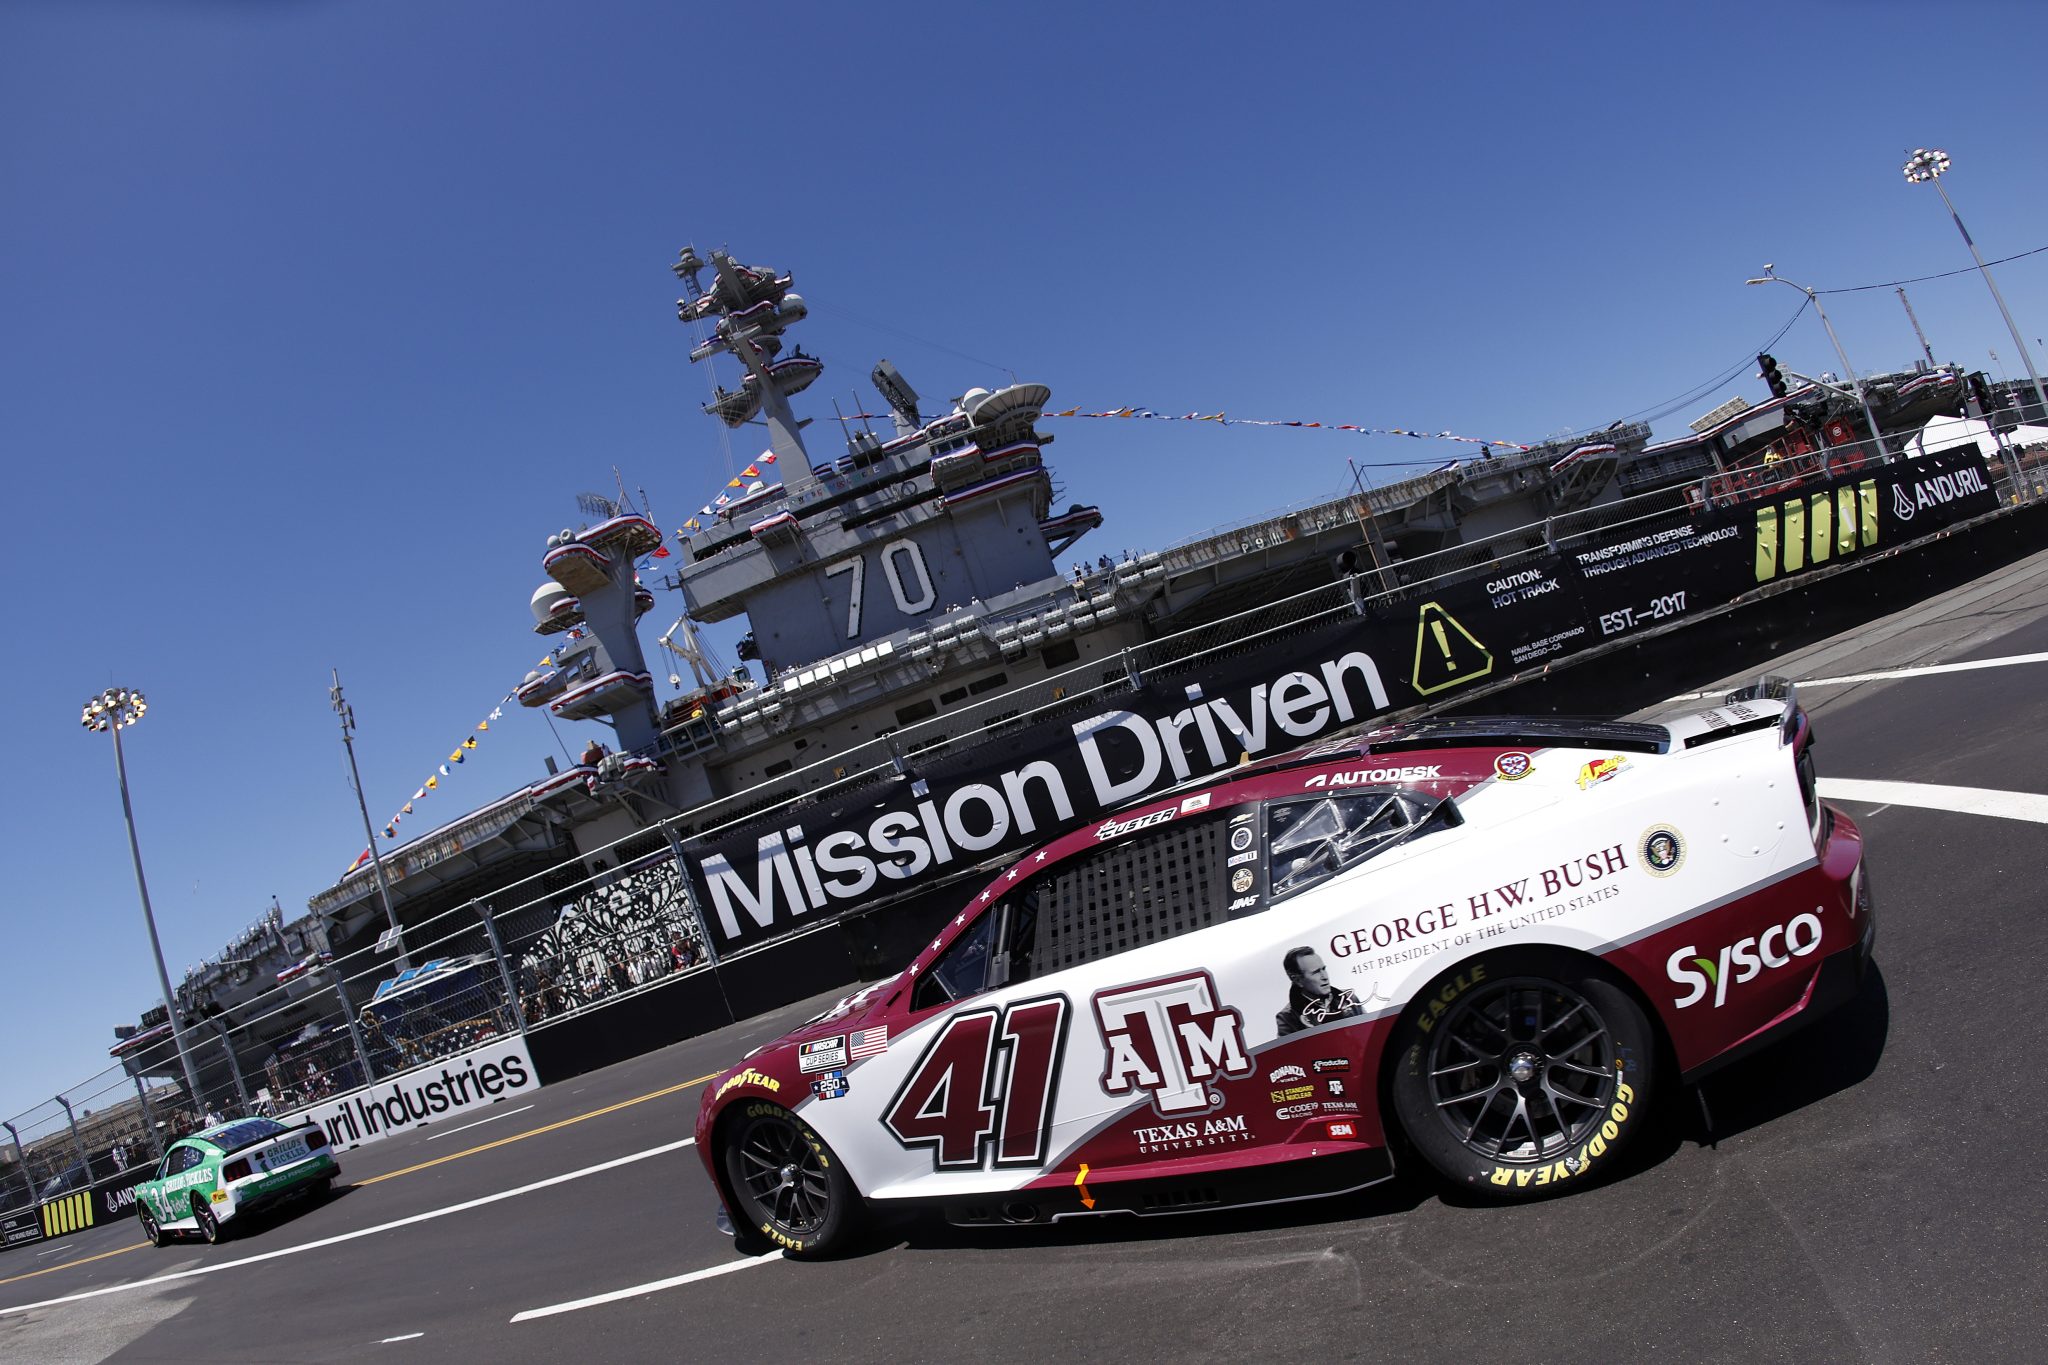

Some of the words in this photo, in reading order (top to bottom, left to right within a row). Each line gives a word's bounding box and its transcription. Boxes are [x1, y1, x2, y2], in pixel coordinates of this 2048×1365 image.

[1914, 467, 1988, 510] ANDURIL
[1576, 537, 1653, 566] TRANSFORMING
[1655, 525, 1695, 543] DEFENSE
[1582, 556, 1632, 578] THROUGH
[1632, 541, 1681, 564] ADVANCED
[1682, 525, 1738, 552] TECHNOLOGY
[825, 538, 938, 640] 70
[1486, 569, 1542, 594] CAUTION:
[1492, 591, 1517, 609] HOT
[1519, 578, 1560, 602] TRACK
[1511, 641, 1532, 657] NAVAL
[1532, 637, 1549, 651] BASE
[1549, 626, 1585, 645] CORONADO
[1514, 653, 1528, 664] SAN
[1329, 765, 1442, 785] AUTODESK
[700, 758, 1074, 940] Mission
[1073, 651, 1389, 803] Driven
[1330, 903, 1459, 959] GEORGE
[1468, 878, 1534, 921] H.W.
[1540, 844, 1629, 898] BUSH
[1351, 959, 1375, 975] 41ST
[1378, 938, 1450, 970] PRESIDENT
[1455, 932, 1473, 947] OF
[1476, 922, 1506, 941] THE
[1509, 904, 1566, 930] UNITED
[1571, 884, 1621, 911] STATES
[1417, 964, 1487, 1033] EAGLE
[806, 1057, 817, 1066] CUP
[818, 1052, 839, 1063] SERIES
[812, 1039, 838, 1053] NASCAR
[716, 1068, 780, 1100] GOODYEAR
[820, 1079, 840, 1091] 250
[879, 992, 1070, 1173] 41
[1270, 1065, 1306, 1083] BONANZA
[356, 1055, 528, 1136] Industries
[1285, 1085, 1314, 1095] STANDARD
[1286, 1092, 1312, 1101] NUCLEAR
[1133, 1122, 1198, 1144] TEXAS
[1204, 1115, 1247, 1135] A&M
[1139, 1132, 1252, 1154] UNIVERSITY
[1330, 1124, 1353, 1136] SEM
[1490, 1083, 1635, 1187] GOODYEAR
[270, 1146, 306, 1166] PICKLES
[761, 1222, 803, 1251] EAGLE
